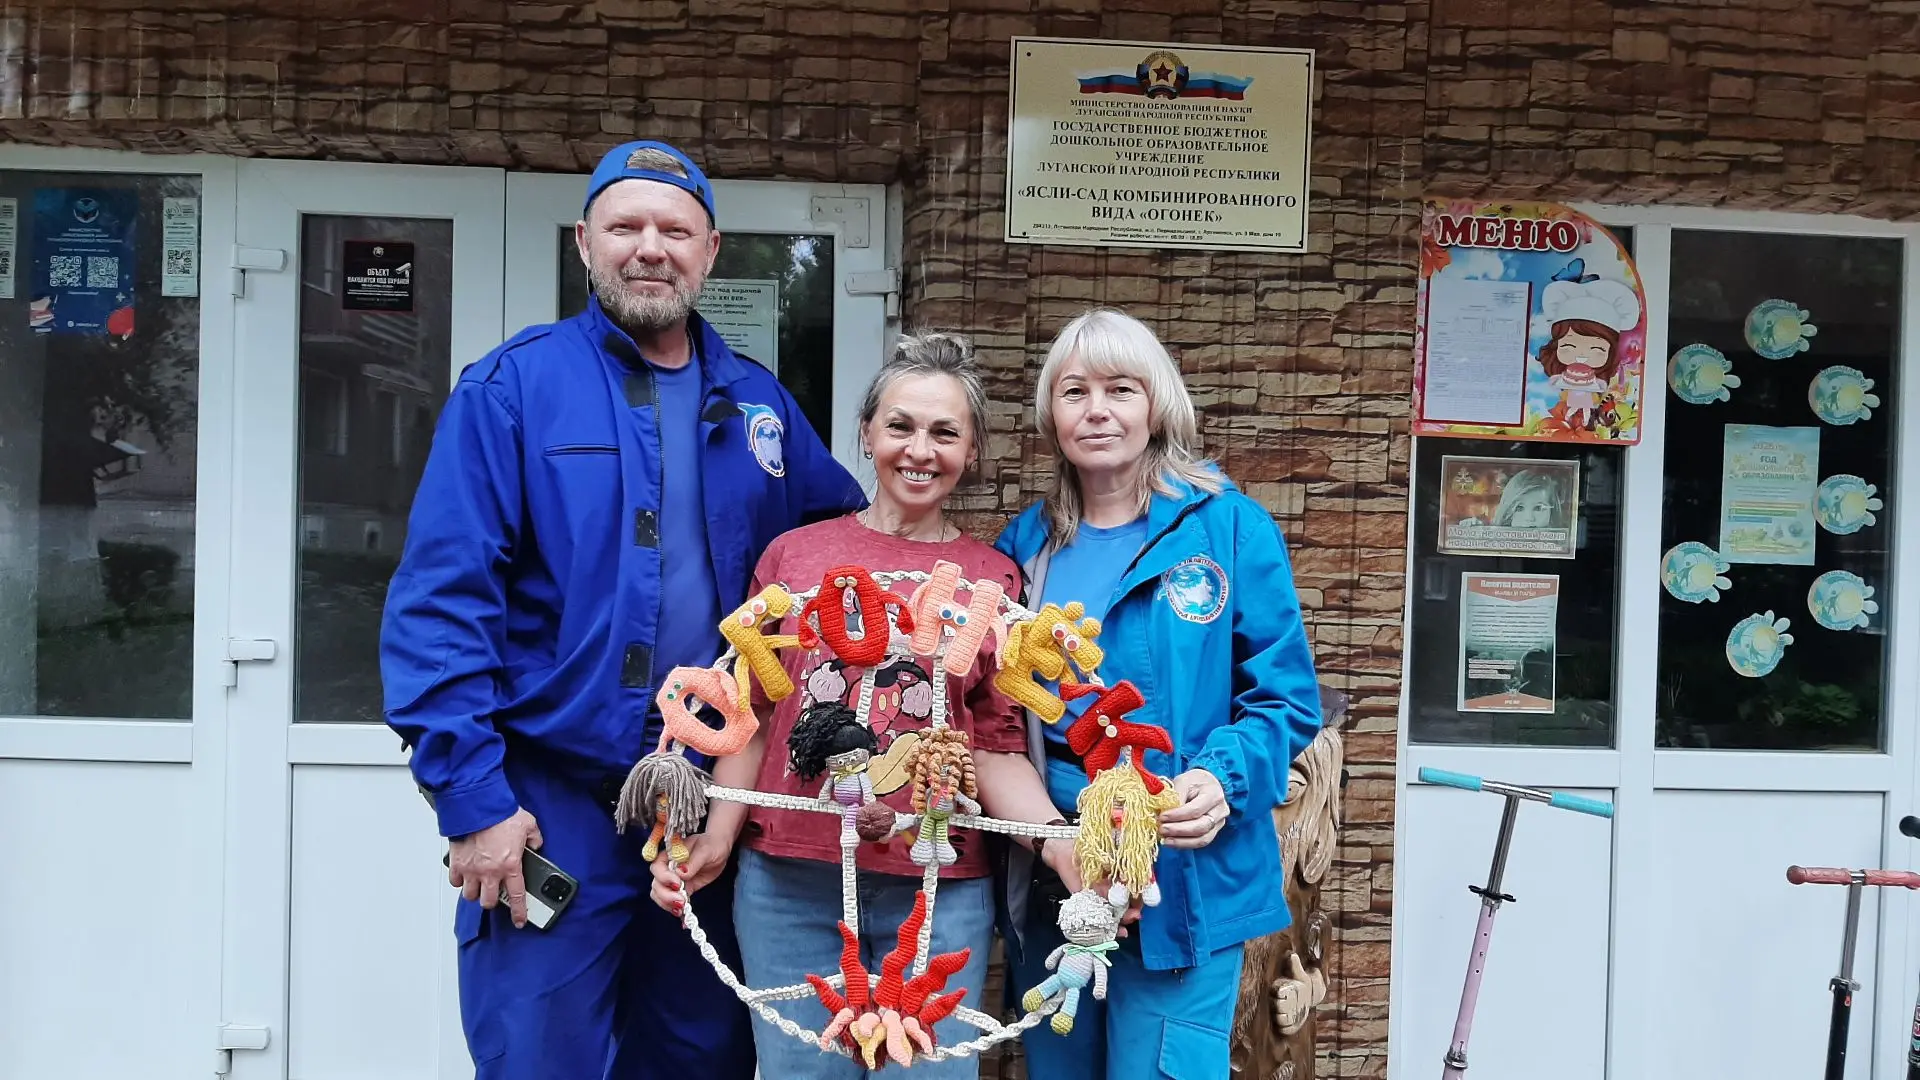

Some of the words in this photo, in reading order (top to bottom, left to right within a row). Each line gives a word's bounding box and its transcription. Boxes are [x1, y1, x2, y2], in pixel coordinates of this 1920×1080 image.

[1053, 120, 1180, 136] ГОСУДАРСТВЕННОЕ
[1184, 126, 1268, 139] БЮДЖЕТНОЕ
[1050, 134, 1143, 148] ДОШКОЛЬНОЕ
[1146, 138, 1269, 152] ОБРАЗОВАТЕЛЬНОЕ
[1115, 151, 1204, 164] УЧРЕЖДЕНИЕ
[1037, 161, 1115, 174] ЛУГАНСКОЙ
[1119, 165, 1189, 178] НАРОДНОЙ
[1193, 168, 1280, 181] РЕСПУБЛИКИ
[1018, 185, 1109, 203] «ЯСЛИ-САД
[1113, 189, 1296, 208] КОМБИНИРОВАННОГО
[1092, 206, 1135, 220] ВИДА
[1140, 208, 1222, 223] «ОГОНЕК»
[1437, 214, 1579, 252] МЕНЮ
